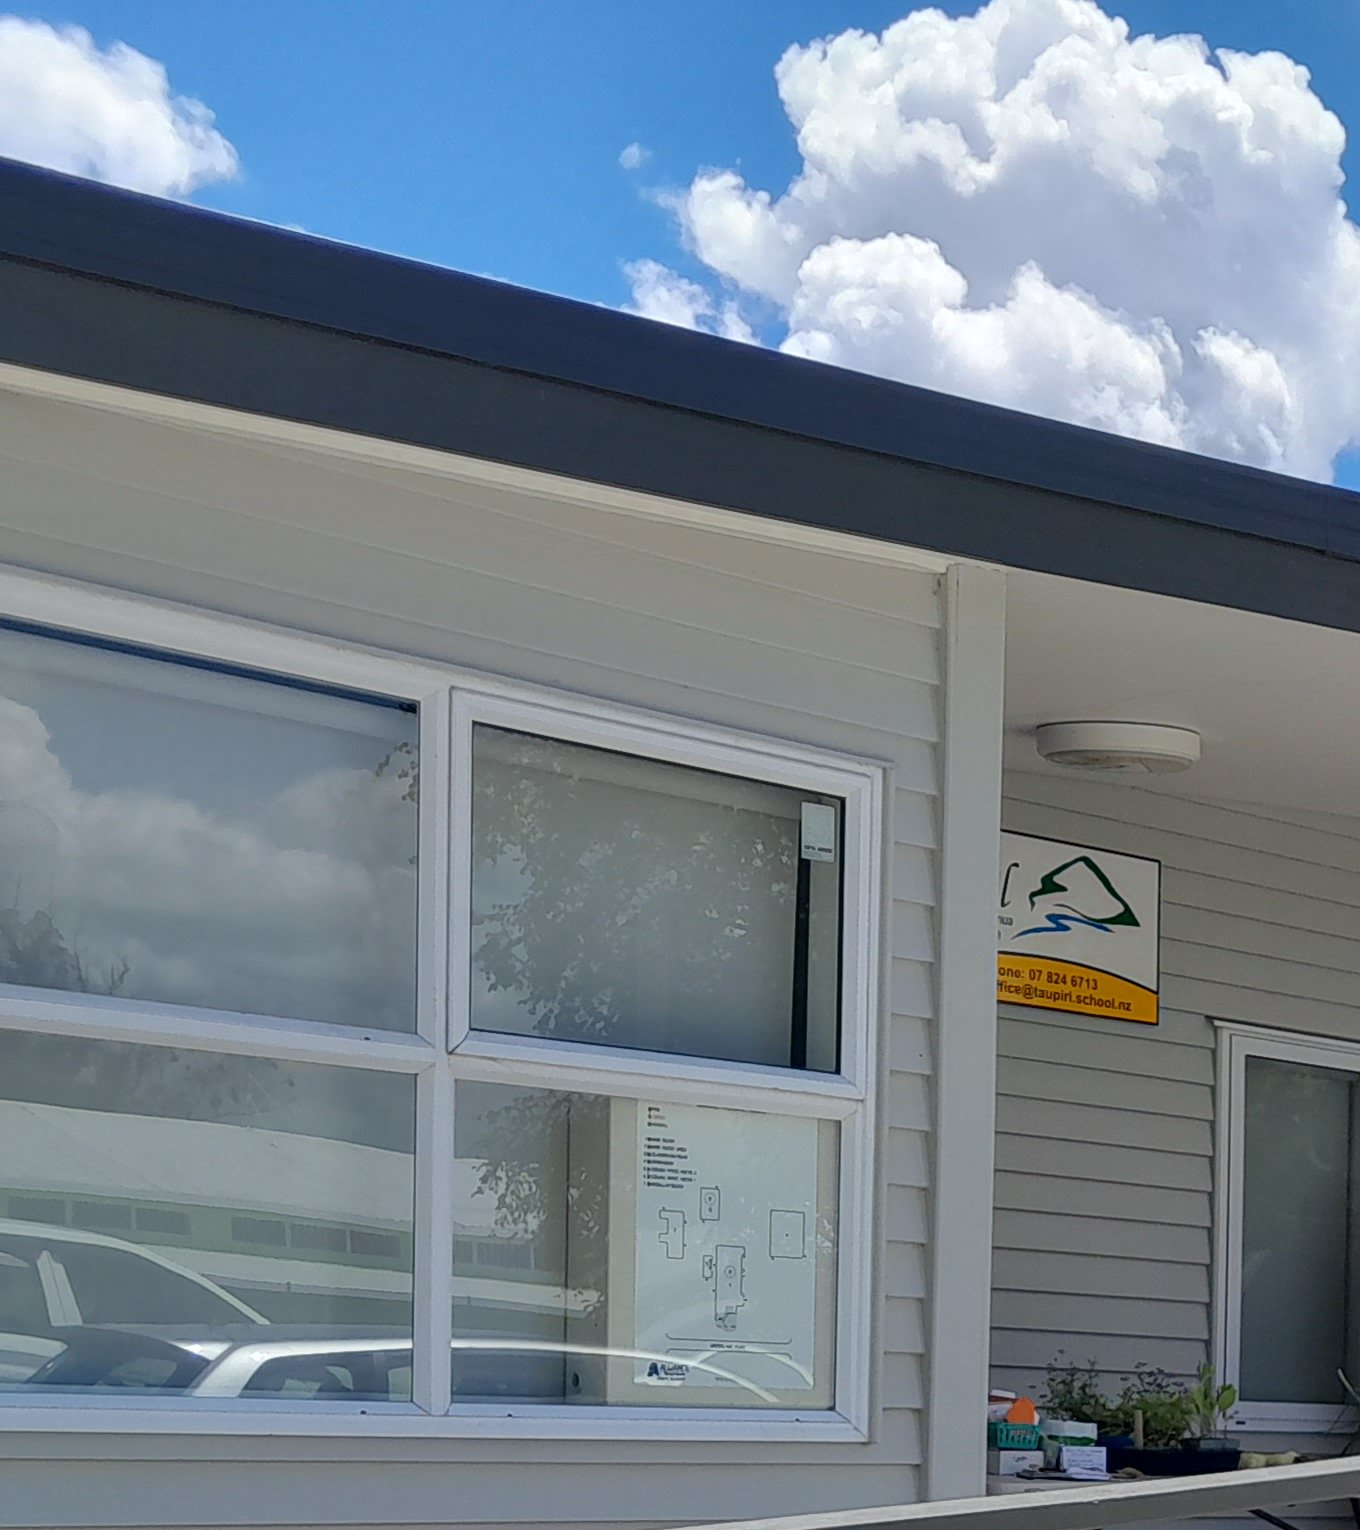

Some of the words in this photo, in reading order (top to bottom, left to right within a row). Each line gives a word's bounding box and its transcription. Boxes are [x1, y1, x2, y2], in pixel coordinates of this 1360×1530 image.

[1028, 969, 1043, 981] 07
[1046, 971, 1067, 986] 824
[1070, 975, 1098, 991] 6713
